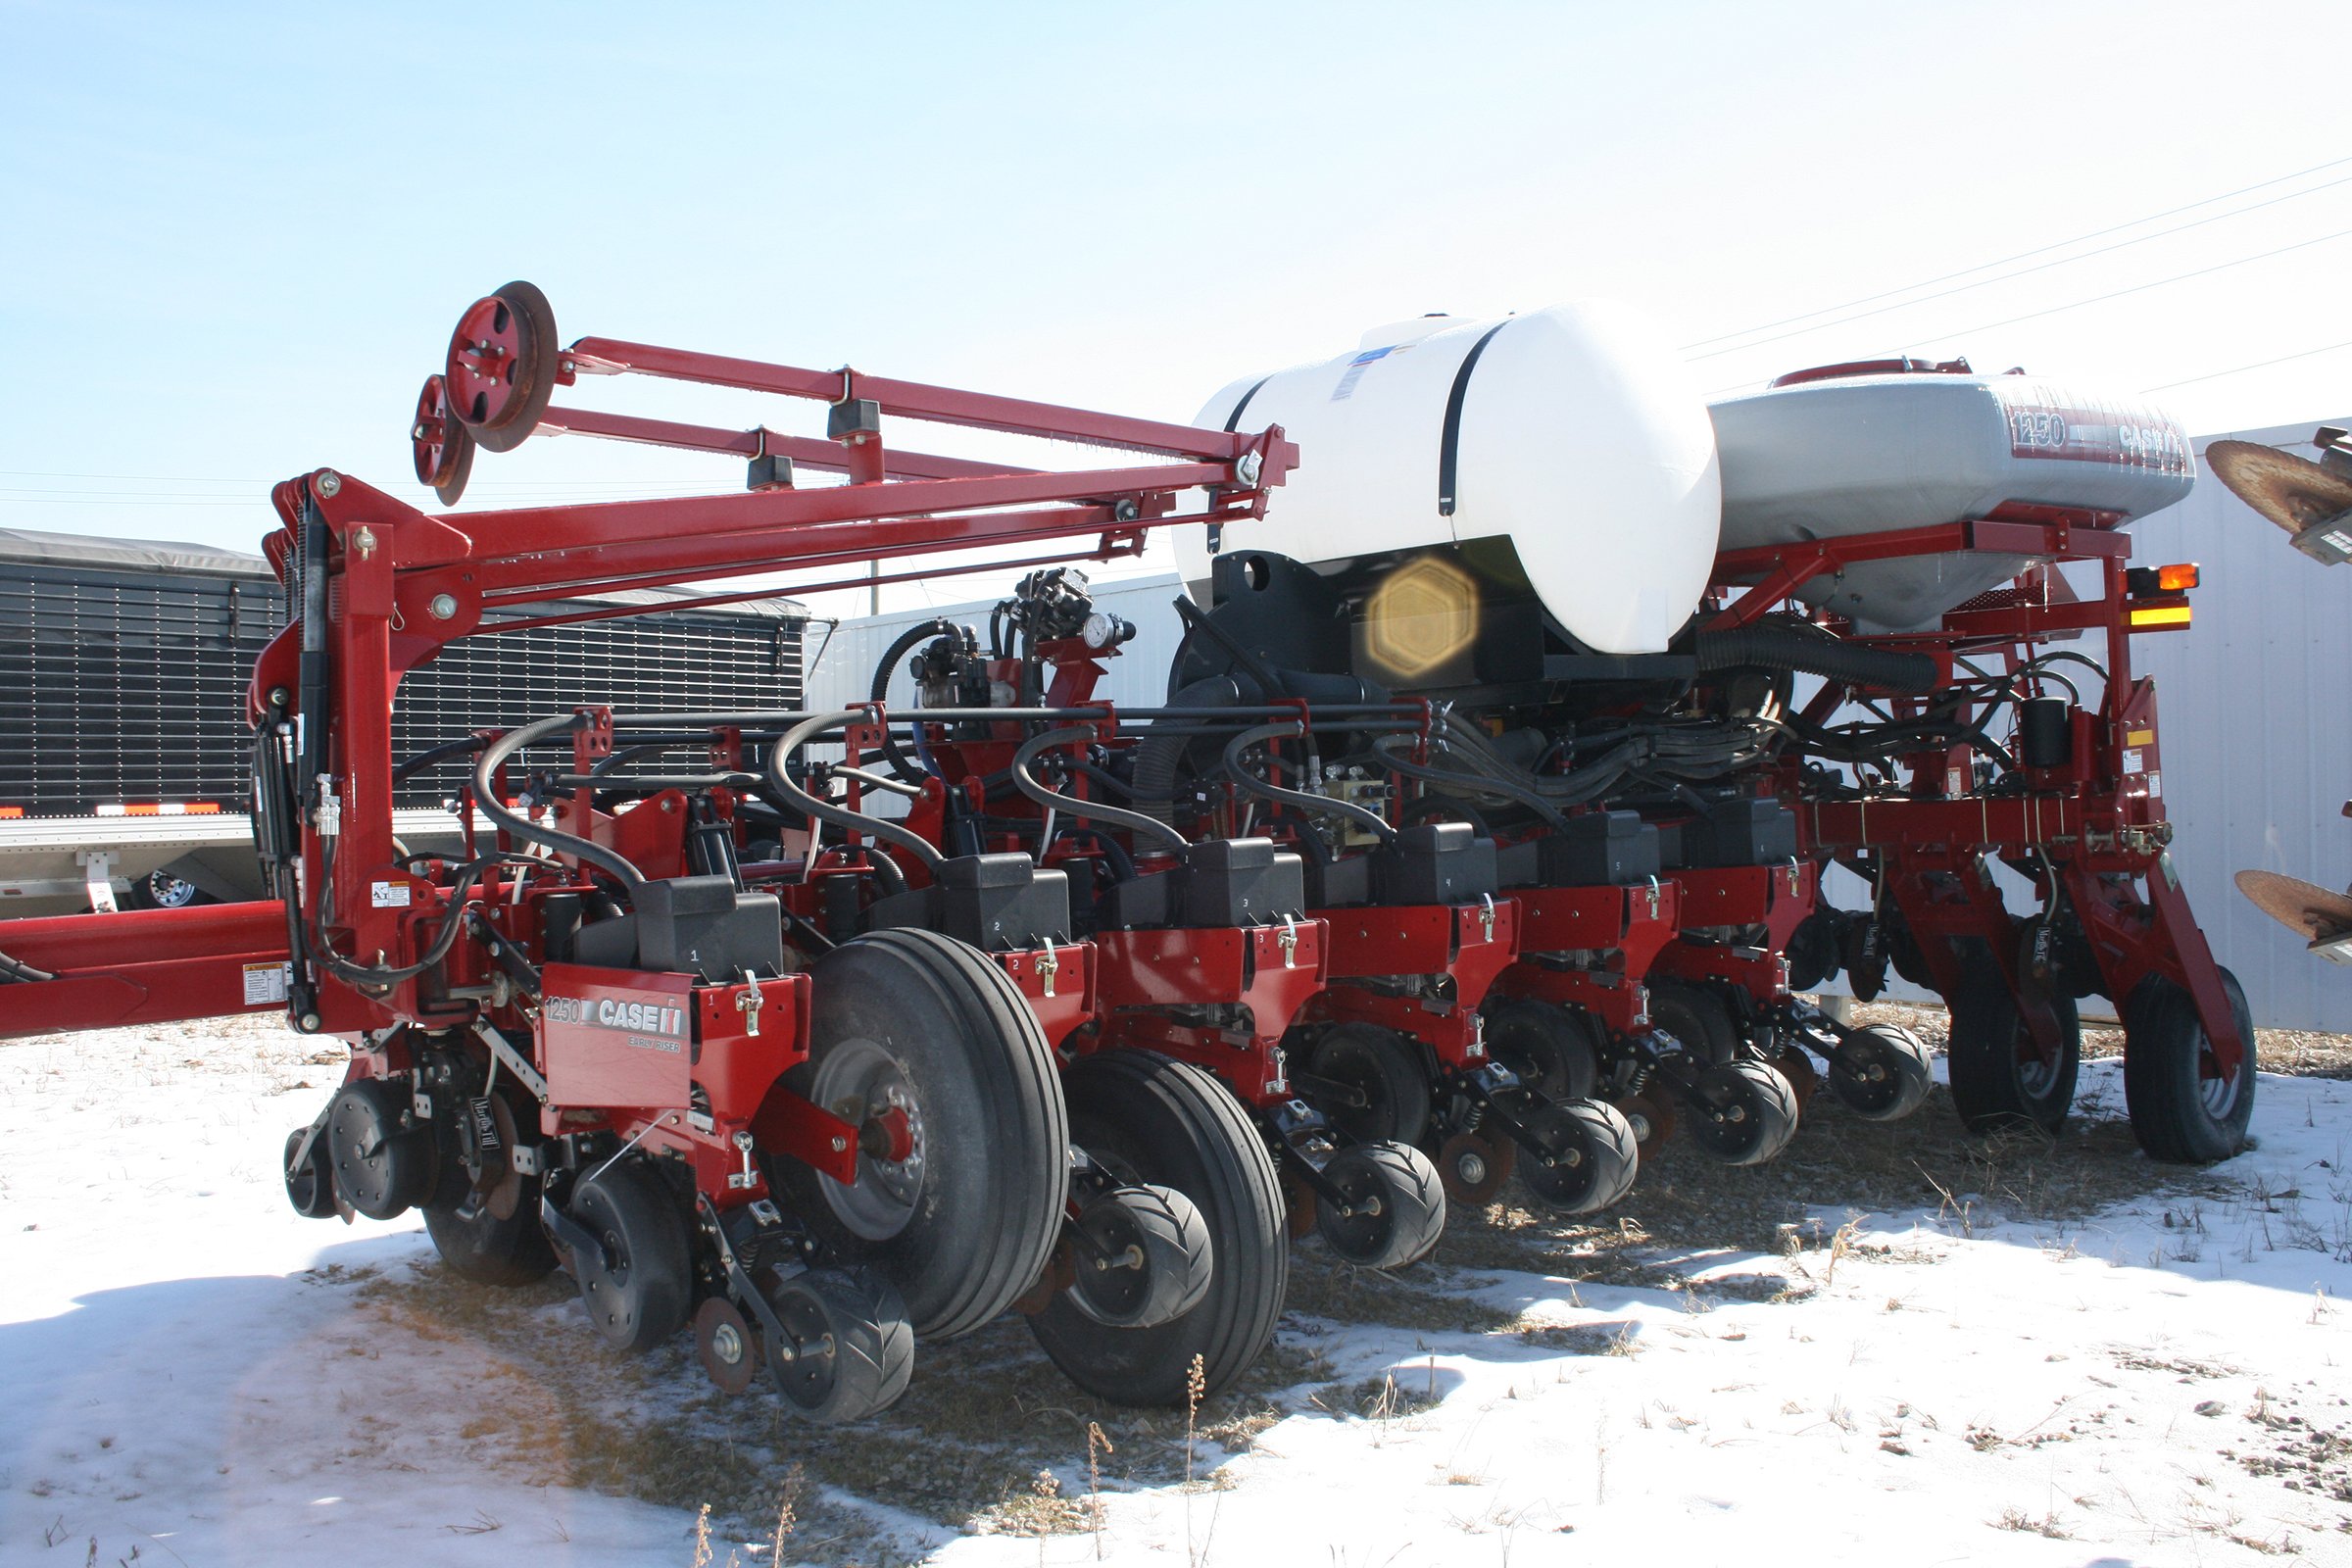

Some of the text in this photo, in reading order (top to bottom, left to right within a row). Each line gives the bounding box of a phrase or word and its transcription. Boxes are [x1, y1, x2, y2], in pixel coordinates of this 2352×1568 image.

[2013, 412, 2065, 447] 1250
[1615, 861, 1621, 871] 5
[1446, 878, 1451, 887] 4
[1631, 891, 1637, 901] 5
[1243, 898, 1249, 907] 3
[1462, 910, 1469, 919] 4
[994, 921, 1001, 931] 2
[1258, 934, 1264, 944] 3
[691, 950, 700, 962] 1
[1012, 959, 1019, 970] 2
[708, 994, 714, 1006] 1
[545, 996, 581, 1025] 1250
[599, 1000, 659, 1032] CASE
[627, 1035, 681, 1054] EARLY RISER
